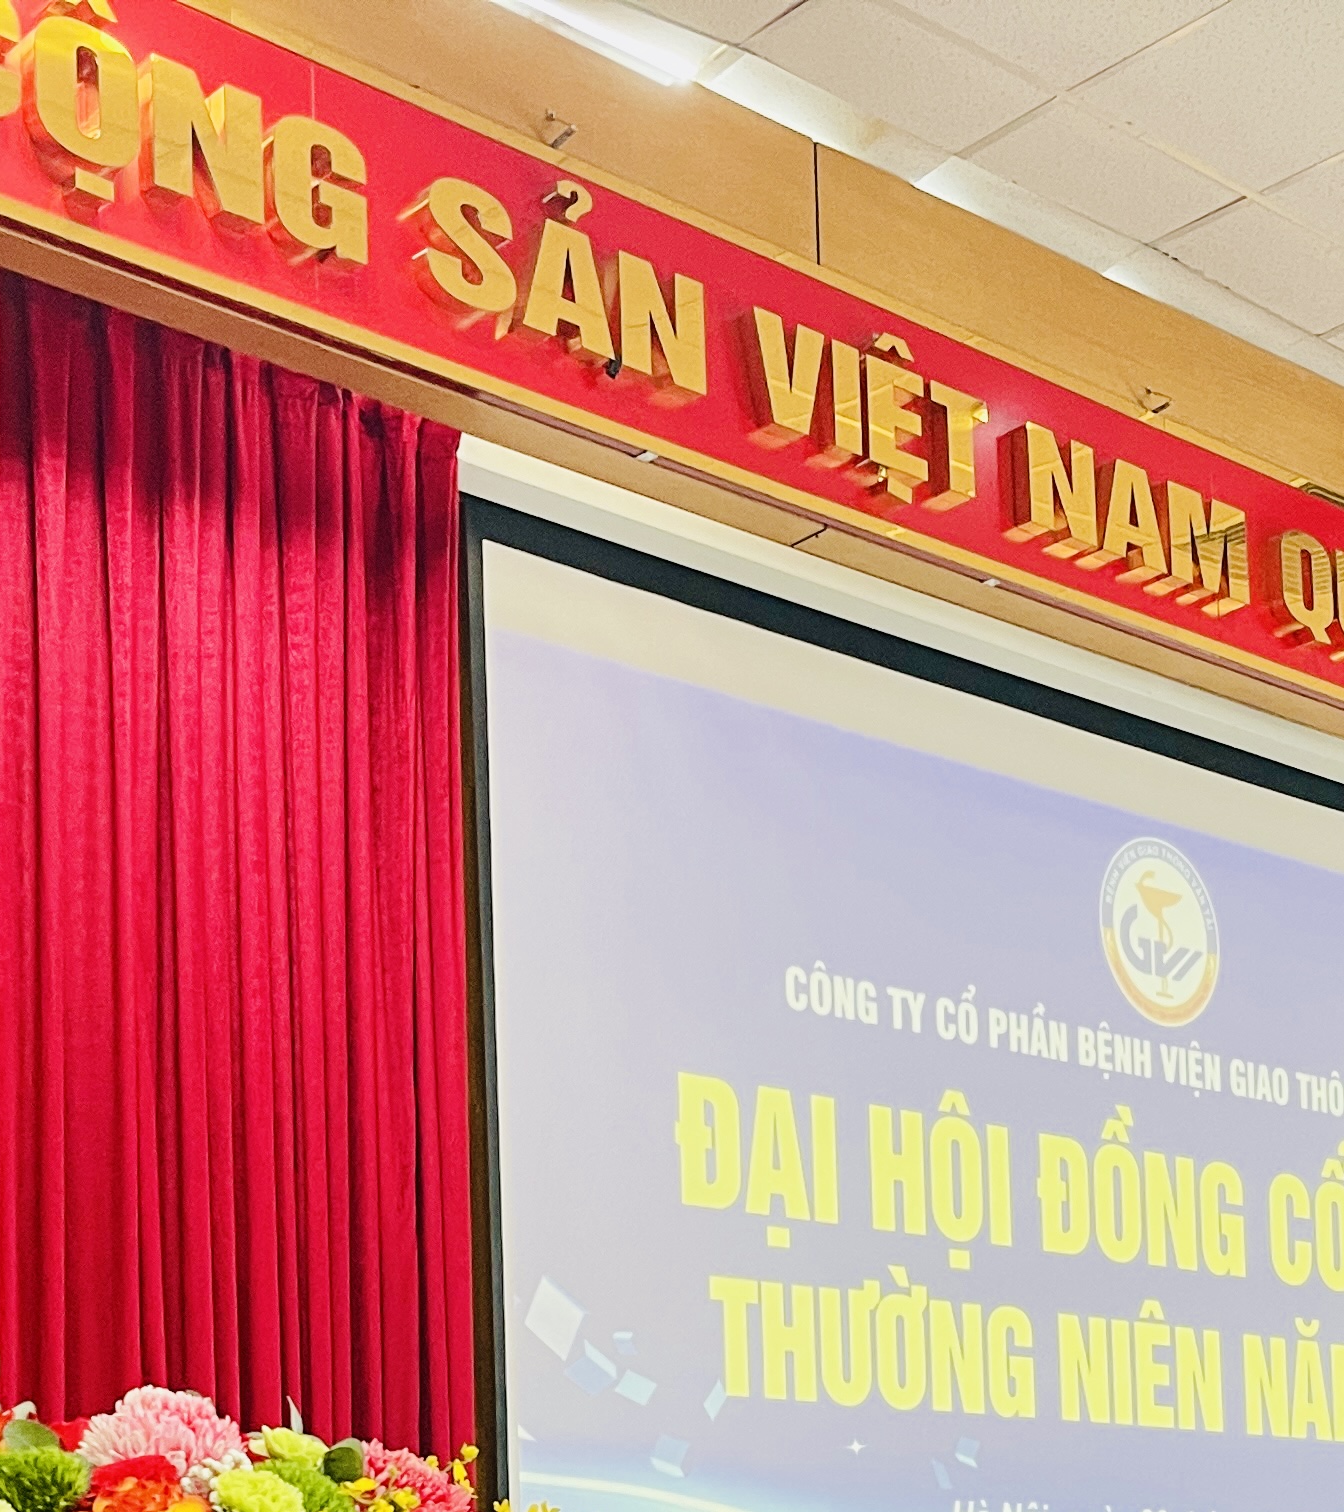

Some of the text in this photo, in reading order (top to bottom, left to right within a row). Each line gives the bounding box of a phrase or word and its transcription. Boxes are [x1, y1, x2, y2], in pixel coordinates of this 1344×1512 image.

[426, 176, 707, 396] SẢN
[753, 305, 989, 505] VIỆT
[1025, 420, 1251, 606] NAM
[784, 960, 879, 1026] CÔNG
[885, 985, 927, 1034] TY
[935, 983, 979, 1046] CỔ
[1076, 1020, 1153, 1080] BỆNH
[1159, 1040, 1222, 1098] VIỆN
[1229, 1058, 1290, 1106] GIAO
[674, 1070, 840, 1249] ĐẠI
[868, 1088, 1013, 1270] HỘI
[1036, 1104, 1247, 1278] ĐỒNG
[708, 1263, 1036, 1419] THƯỜNG
[1056, 1298, 1226, 1433] NIÊN
